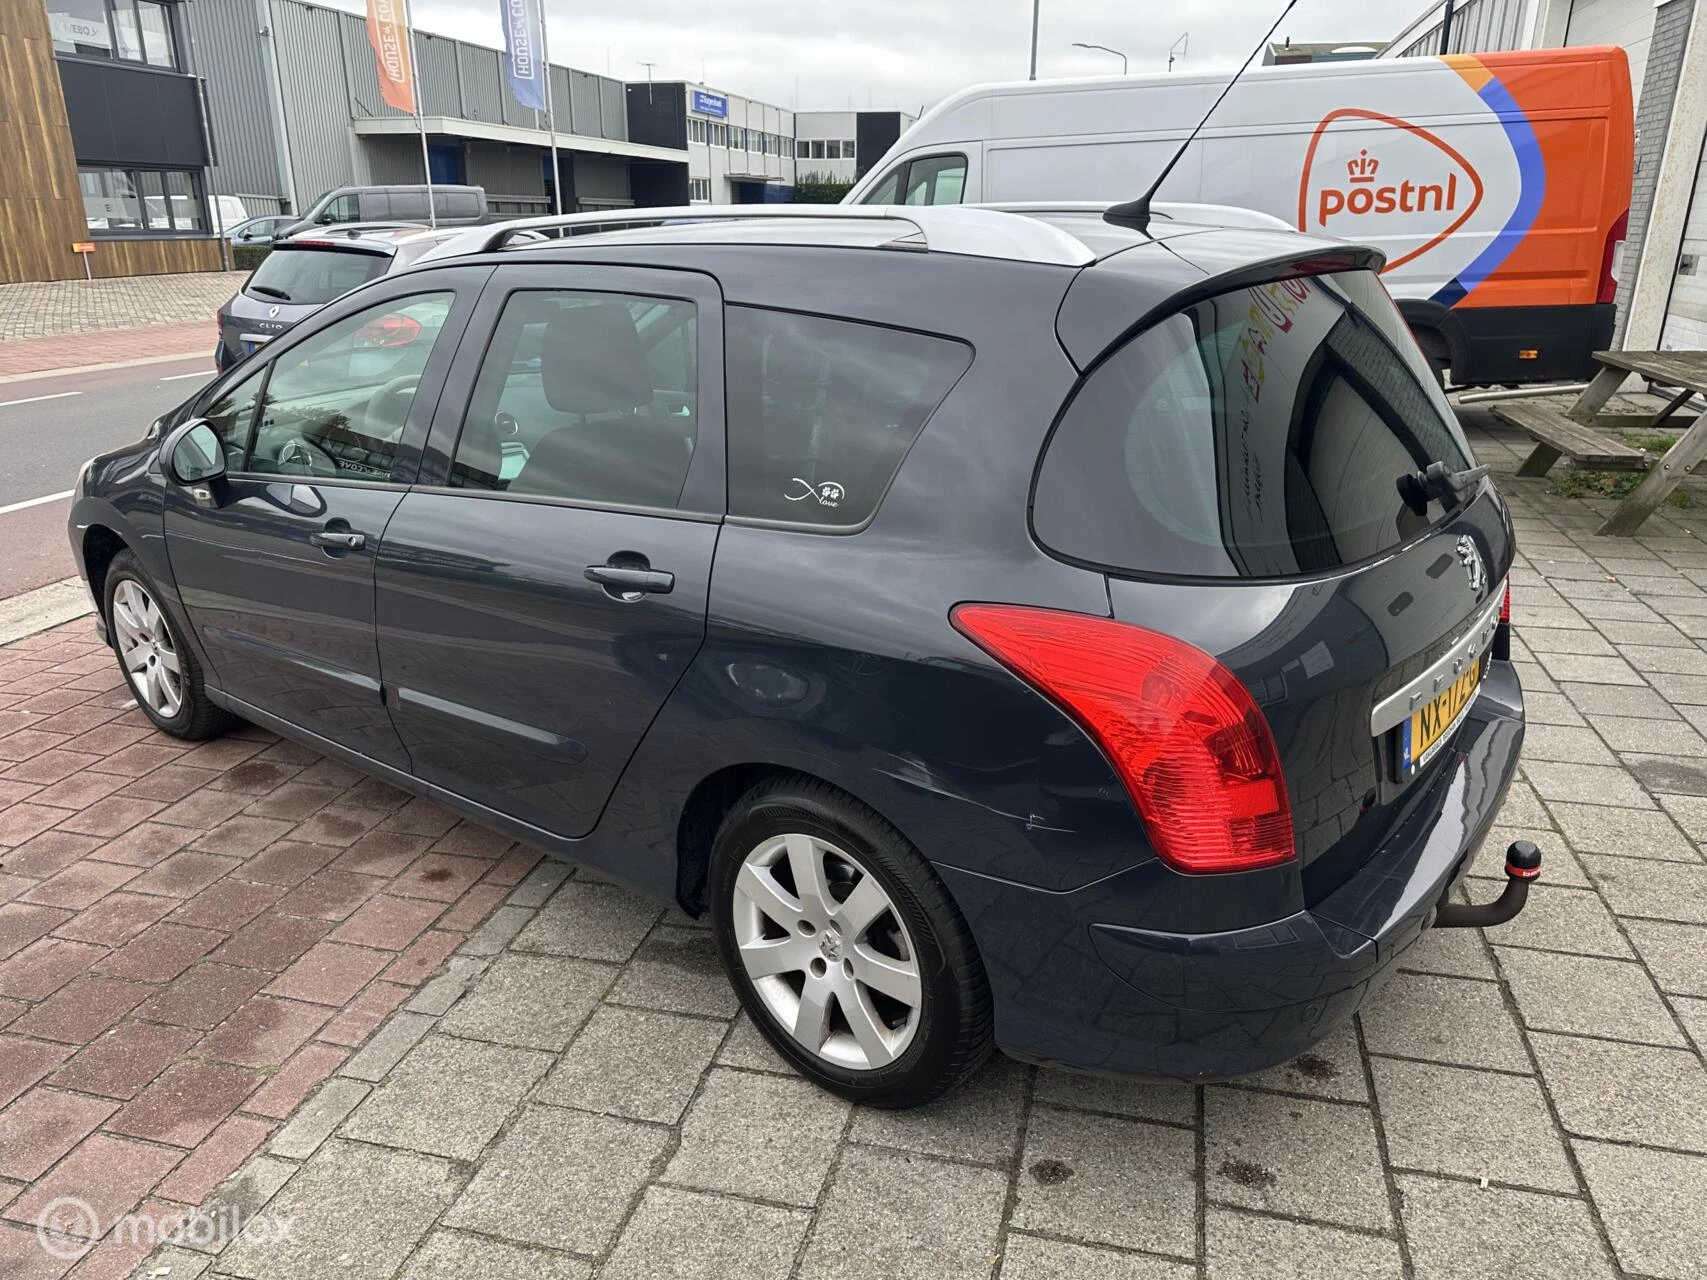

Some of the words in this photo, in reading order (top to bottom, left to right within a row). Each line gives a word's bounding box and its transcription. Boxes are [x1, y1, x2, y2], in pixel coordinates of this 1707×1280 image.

[1319, 171, 1456, 227] postnl
[259, 322, 283, 330] CLIO
[820, 496, 839, 508] love
